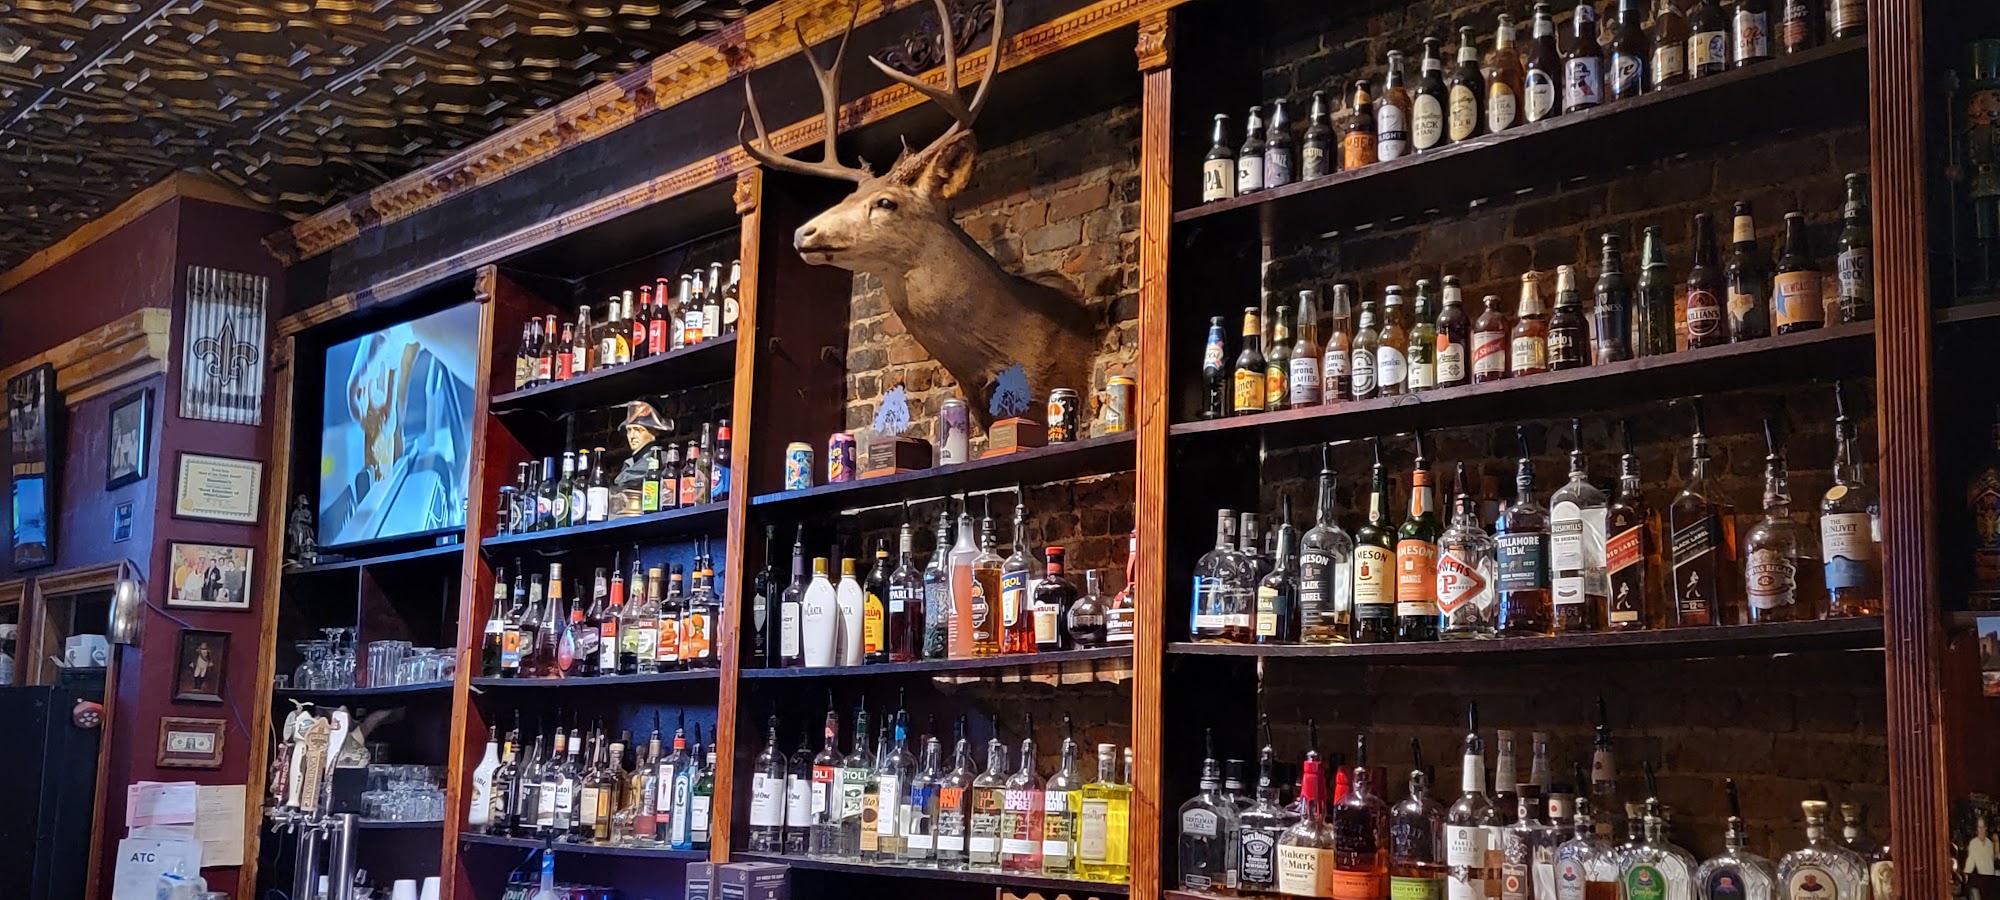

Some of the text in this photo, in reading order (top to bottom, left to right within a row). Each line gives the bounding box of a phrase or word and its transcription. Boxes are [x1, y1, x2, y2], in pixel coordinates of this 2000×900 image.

[1415, 121, 1439, 131] LACK
[1345, 137, 1374, 151] MBER
[1548, 331, 1568, 347] odelo
[1823, 523, 1858, 534] ENLIVET
[1498, 536, 1540, 549] TULLAMORE
[1618, 538, 1640, 554] LABEL
[130, 852, 156, 863] ATC
[1280, 848, 1316, 861] Maker's
[1288, 859, 1315, 871] Mark
